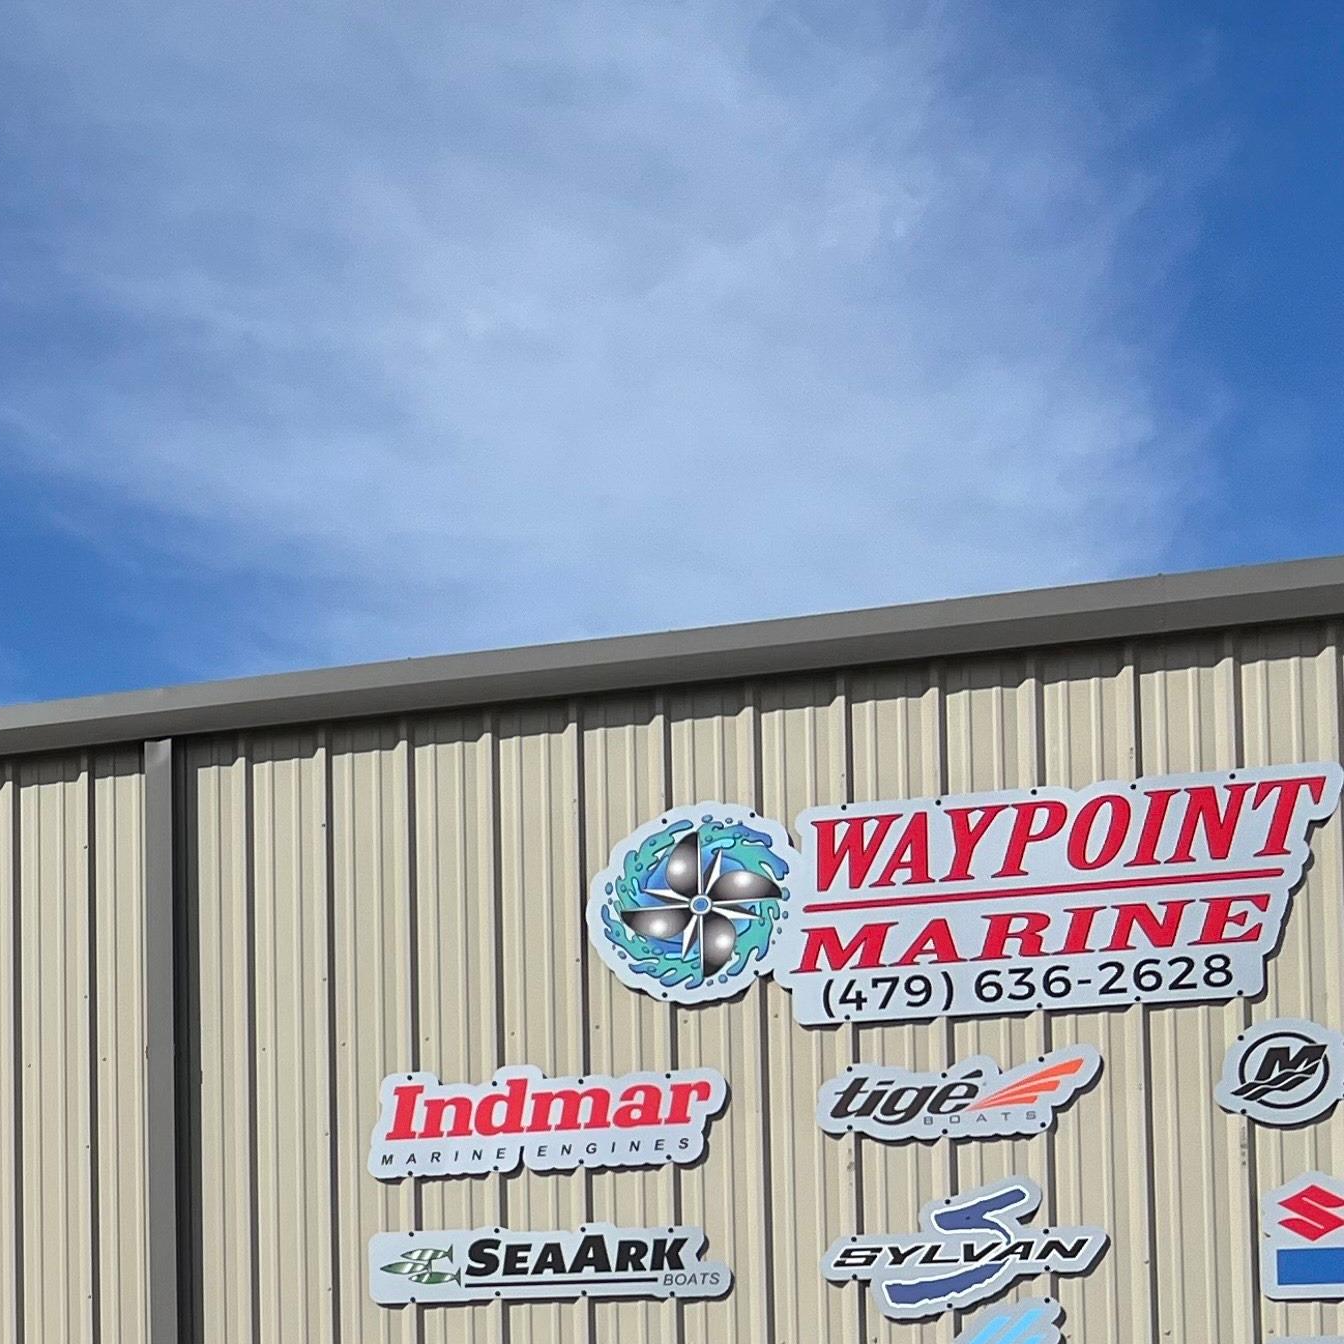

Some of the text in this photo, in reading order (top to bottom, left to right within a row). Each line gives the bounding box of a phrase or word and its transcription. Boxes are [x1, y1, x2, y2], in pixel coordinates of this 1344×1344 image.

[811, 775, 1326, 892] WAYPOINT
[790, 893, 1271, 974] MARINE
[822, 954, 1234, 1019] (479) 636-2628
[385, 1078, 711, 1141] Indmar
[830, 1069, 983, 1125] tigé
[923, 1111, 1037, 1126] BOATS
[381, 1137, 690, 1167] MARINE ENGINES
[663, 1271, 721, 1287] BOATS
[832, 1238, 1090, 1268] SYLVAN
